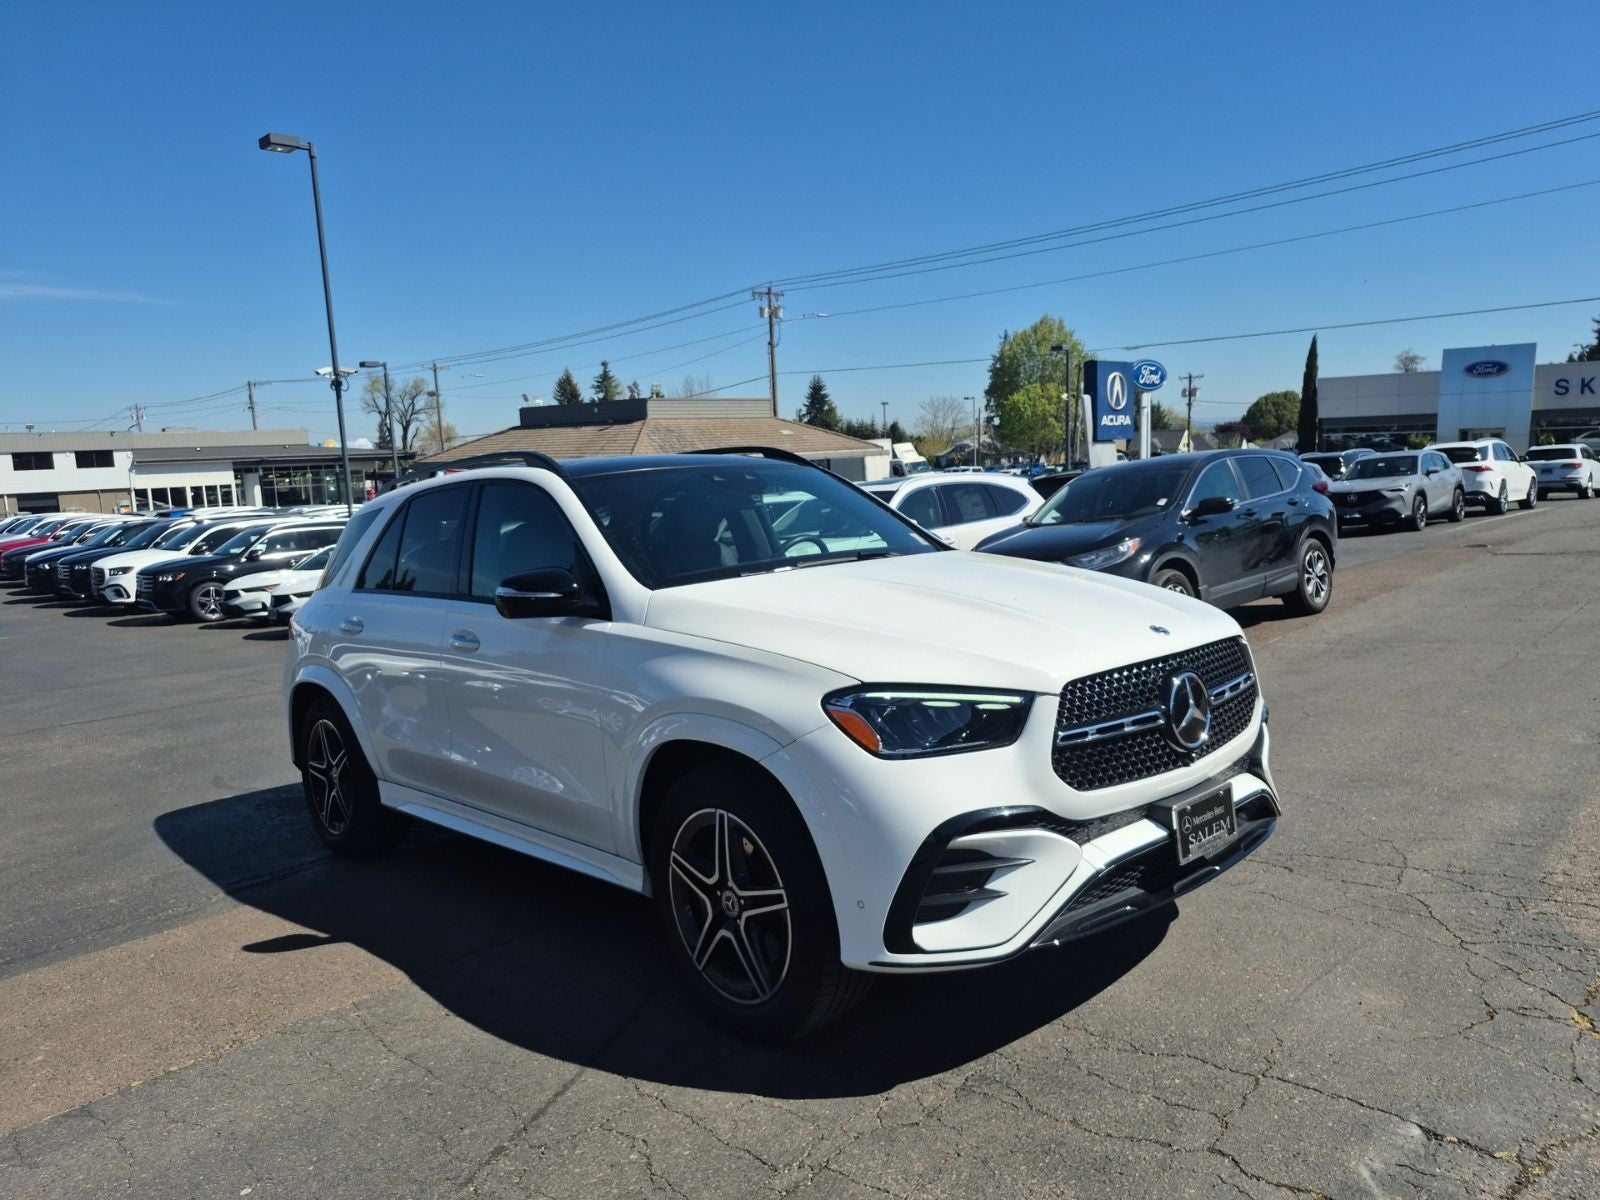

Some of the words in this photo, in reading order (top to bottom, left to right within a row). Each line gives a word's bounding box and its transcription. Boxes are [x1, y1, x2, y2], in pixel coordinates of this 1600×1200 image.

[1139, 365, 1162, 385] Ford
[1473, 363, 1499, 375] Ford
[1101, 415, 1131, 426] ACURA
[1192, 805, 1225, 826] Mercedes-Benz
[1188, 816, 1231, 847] SALEM
